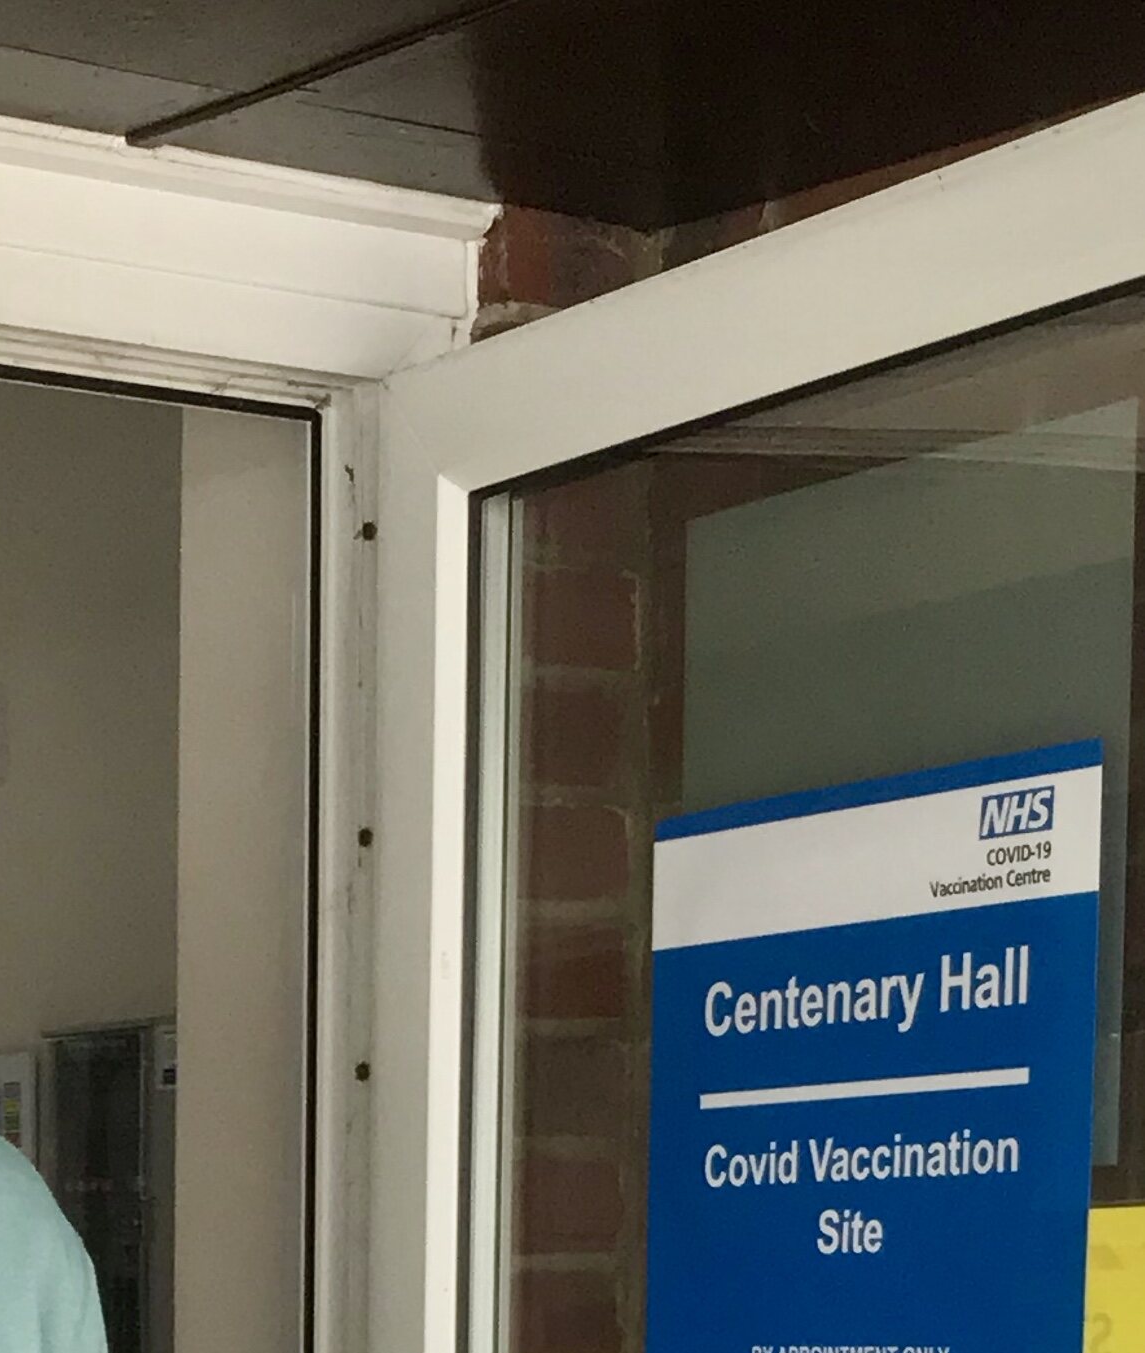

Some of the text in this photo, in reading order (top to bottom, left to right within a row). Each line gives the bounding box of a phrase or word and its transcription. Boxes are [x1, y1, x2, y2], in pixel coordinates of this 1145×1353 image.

[981, 789, 1052, 837] NHS
[986, 840, 1053, 867] COVID-19
[929, 867, 1051, 898] Vaccination Centre
[704, 944, 1030, 1037] Centenary Hall
[704, 1128, 1019, 1188] Covid Vaccination
[816, 1209, 884, 1255] Site
